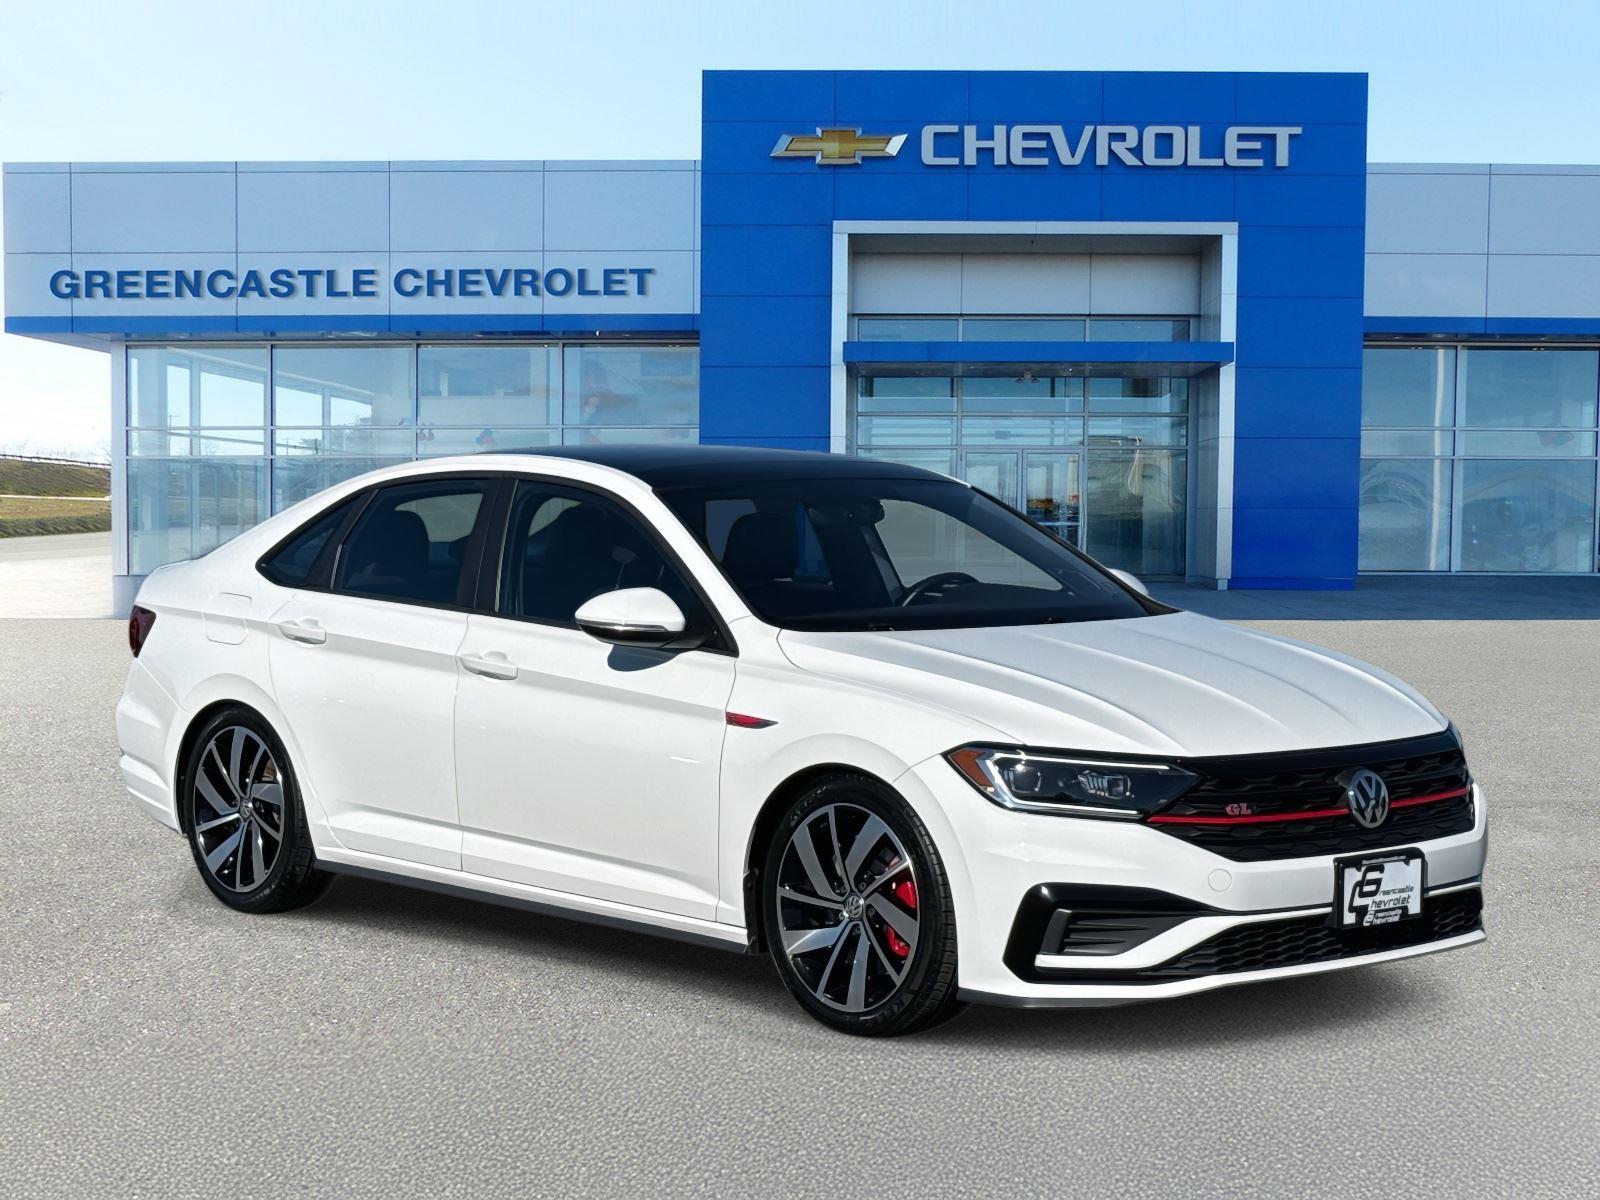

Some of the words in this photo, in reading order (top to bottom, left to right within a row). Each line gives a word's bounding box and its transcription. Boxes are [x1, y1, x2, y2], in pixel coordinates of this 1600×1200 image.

[921, 124, 1303, 168] CHEVROLET
[50, 269, 379, 299] GREENCASTLE
[395, 267, 654, 296] CHEVROLET
